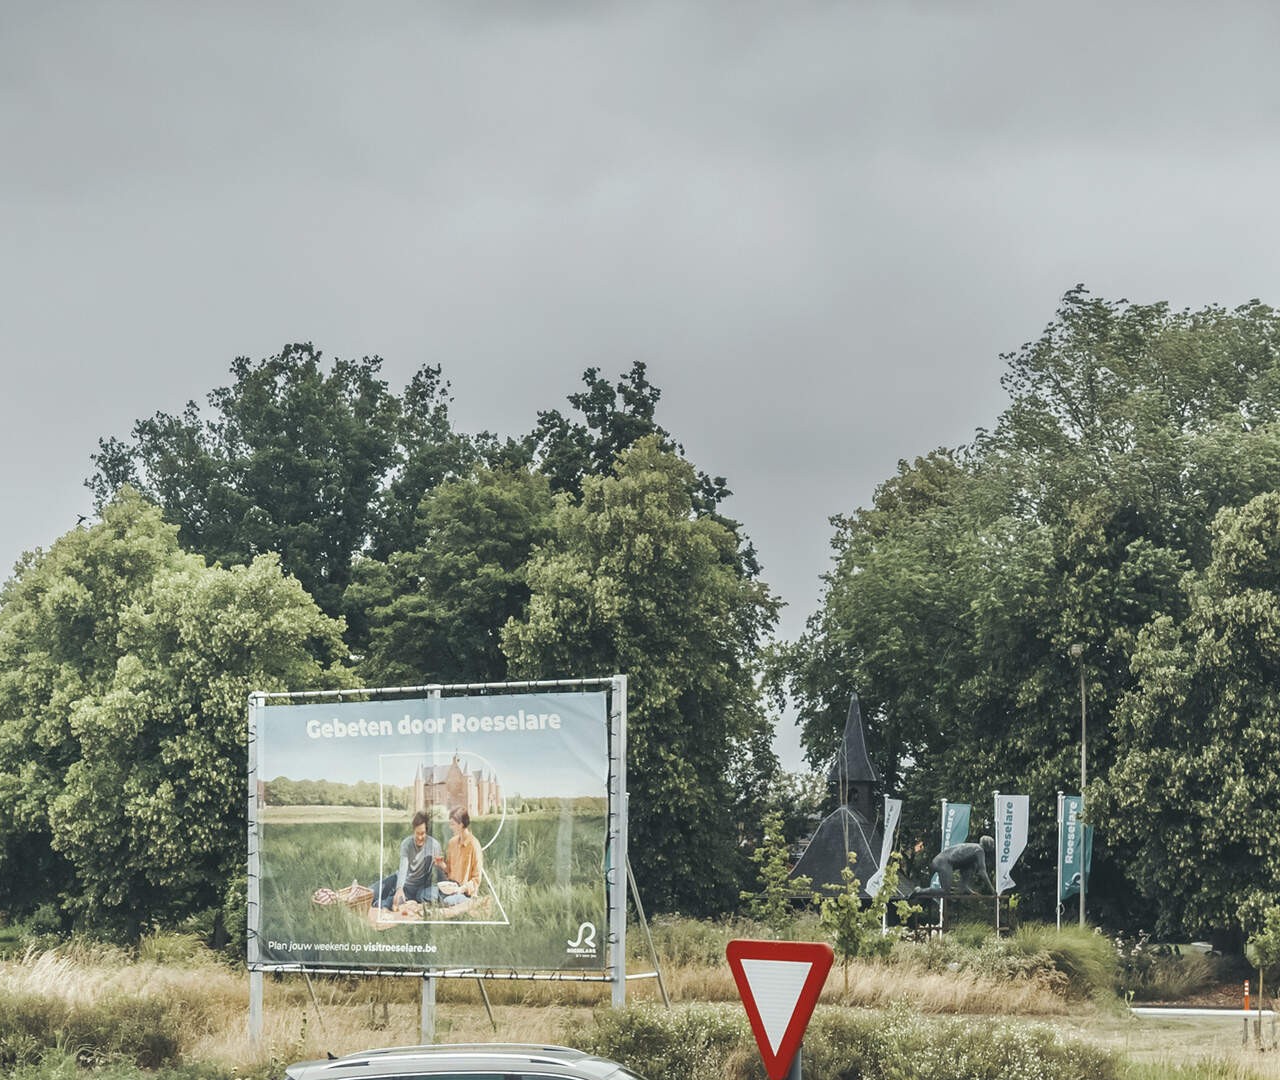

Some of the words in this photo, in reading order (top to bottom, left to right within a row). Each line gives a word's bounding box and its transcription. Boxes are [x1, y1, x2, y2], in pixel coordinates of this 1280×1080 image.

[306, 718, 393, 739] Gebeten
[397, 715, 446, 735] door
[451, 710, 561, 733] Roeselare
[1000, 801, 1014, 864] Roeselare
[1065, 801, 1078, 864] Roeselare
[269, 941, 287, 951] Plan
[288, 941, 313, 952] jouw
[314, 941, 350, 951] weekend
[351, 943, 362, 953] op
[363, 942, 438, 953] visitroeselare.be
